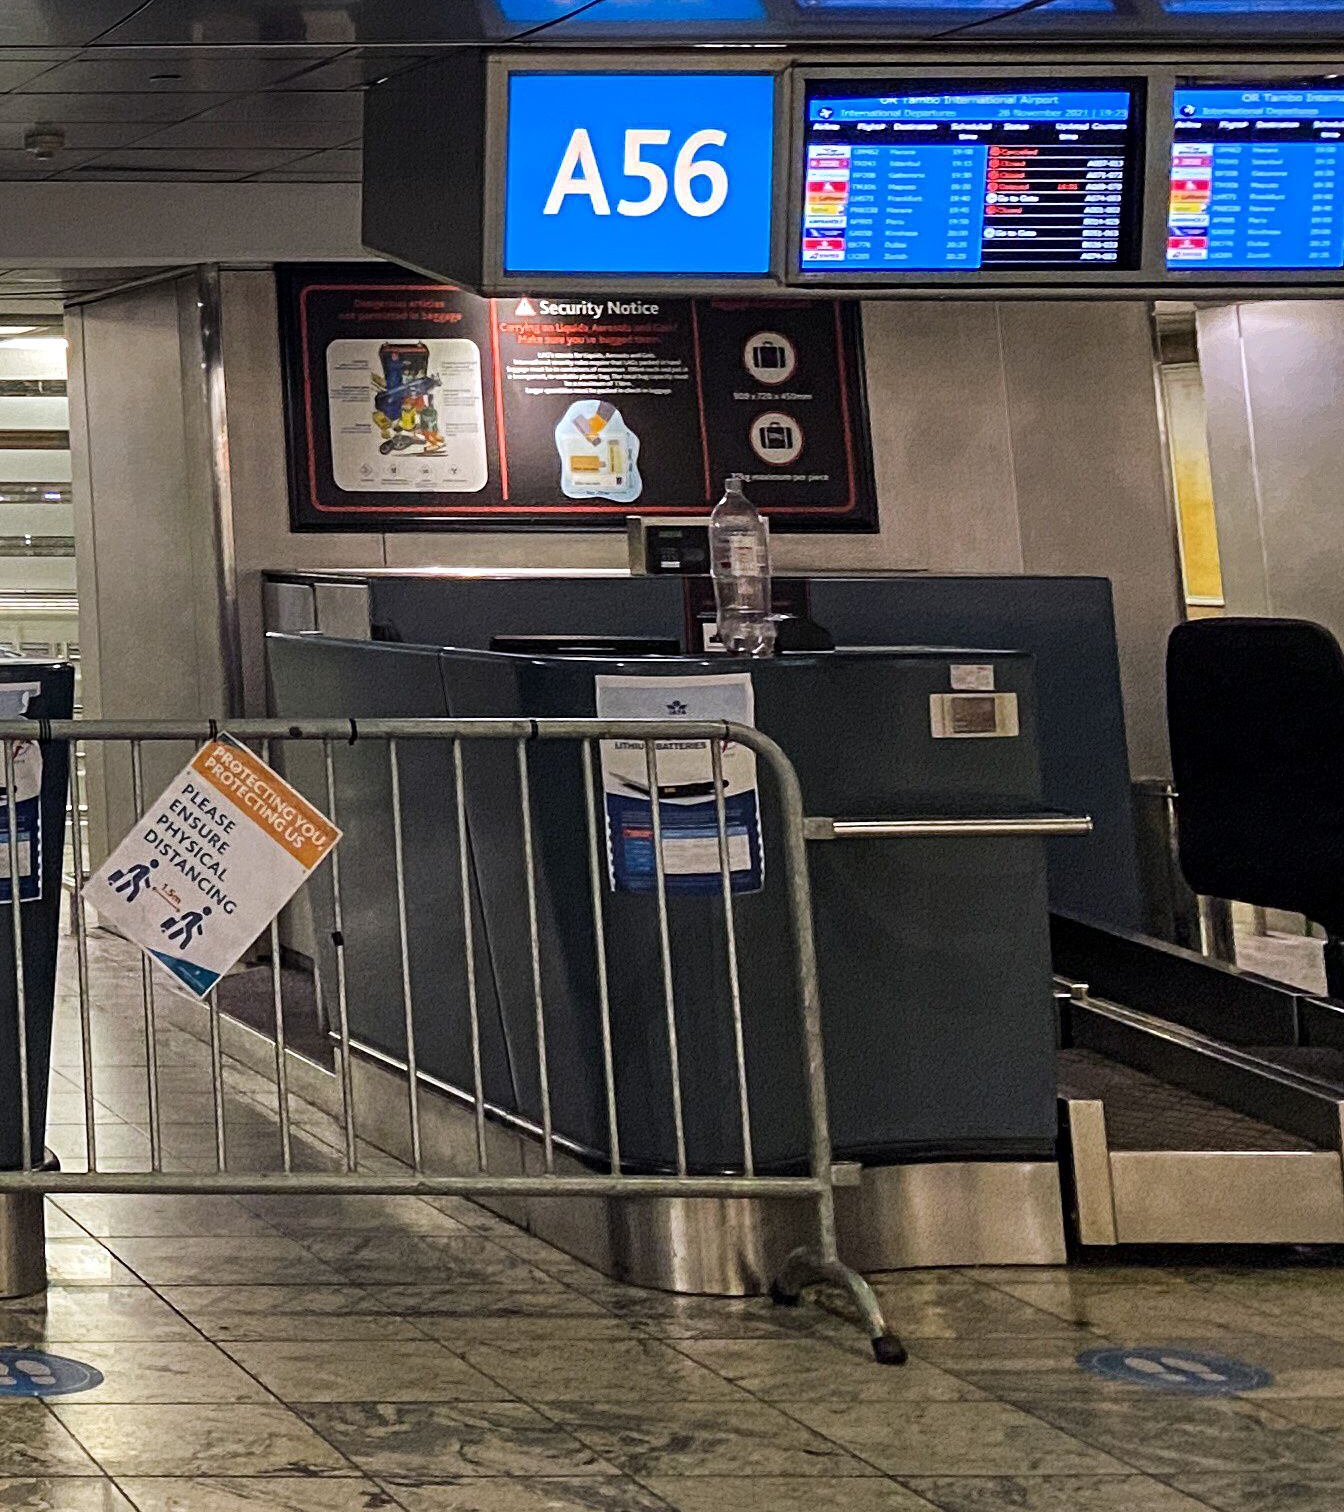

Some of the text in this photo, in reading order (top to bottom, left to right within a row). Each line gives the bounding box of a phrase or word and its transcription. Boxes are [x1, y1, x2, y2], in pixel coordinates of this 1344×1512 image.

[542, 128, 729, 218] A56
[539, 301, 660, 318] Security Notice
[656, 741, 706, 750] BATTERIES
[182, 784, 236, 834] PLEASE
[204, 757, 305, 849] PROTECTING US
[213, 746, 293, 820] PROTECTING
[156, 814, 231, 882] PHYSICAL
[169, 798, 230, 855] ENSURE
[144, 829, 237, 915] DISTANCING
[161, 883, 182, 904] 1.5m
